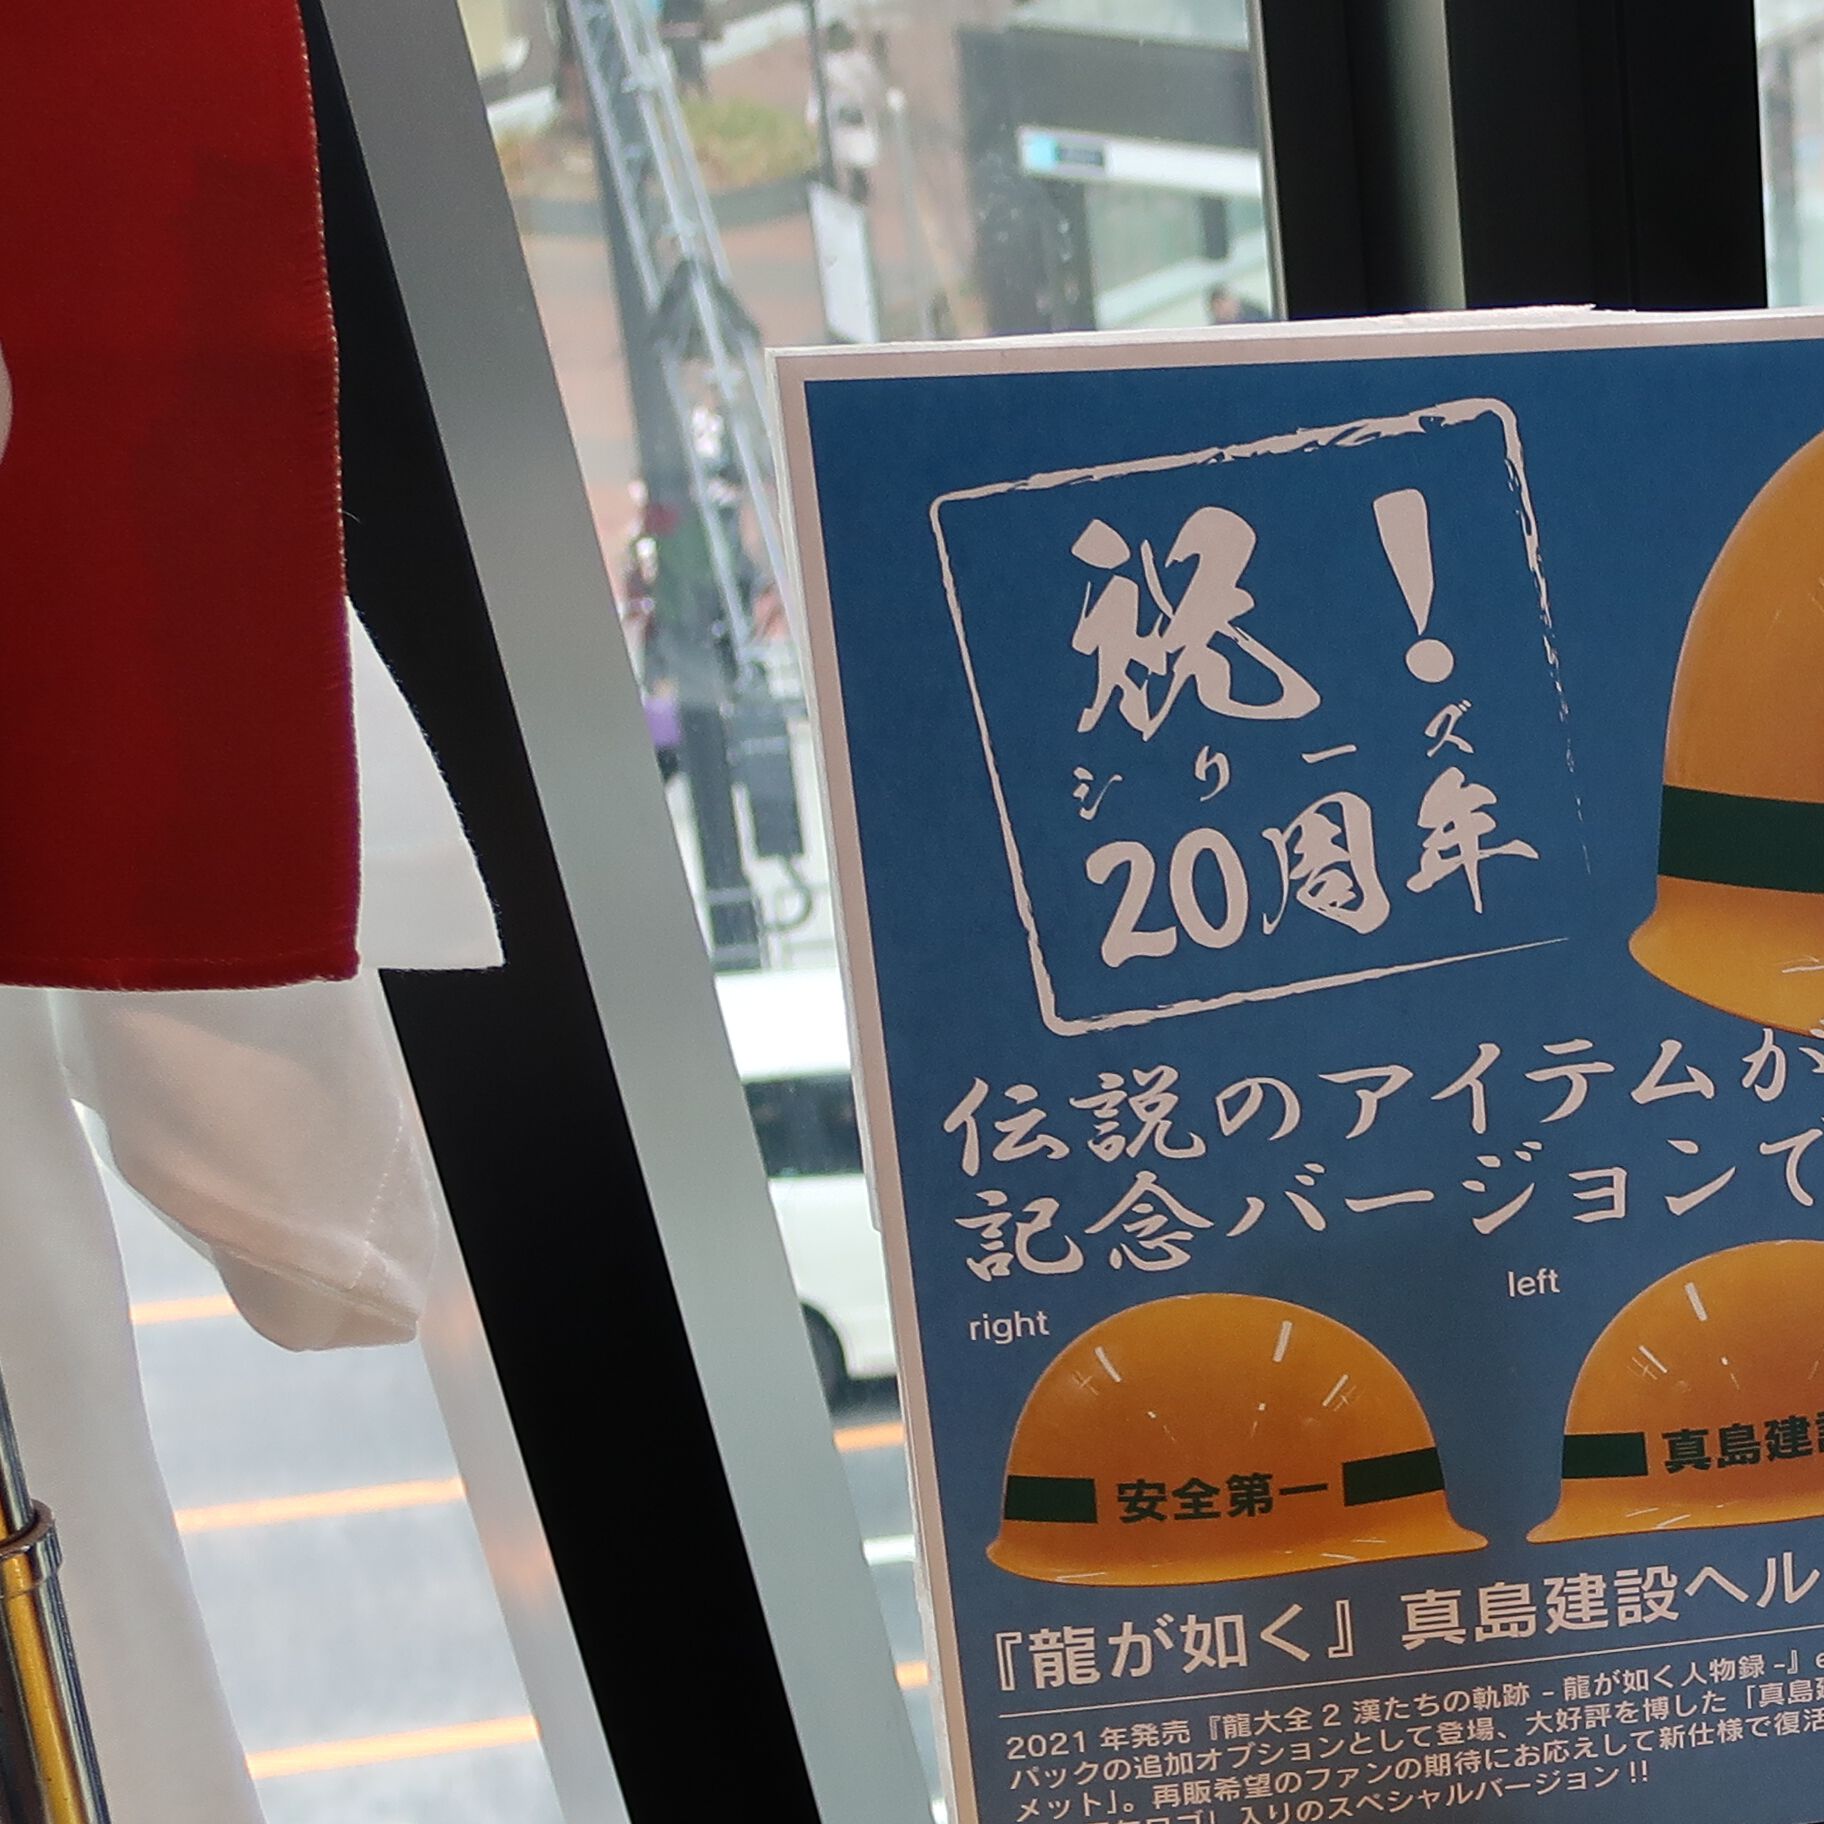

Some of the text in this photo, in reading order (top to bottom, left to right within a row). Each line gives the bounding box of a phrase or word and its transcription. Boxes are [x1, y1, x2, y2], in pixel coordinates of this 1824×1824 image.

[1086, 766, 1539, 968] 20周年
[1507, 1268, 1560, 1298] left
[968, 1310, 1050, 1345] right
[1115, 1474, 1328, 1525] 安全第一
[995, 1599, 1356, 1693] 『龍が如く』
[1006, 1730, 1086, 1761] 2021
